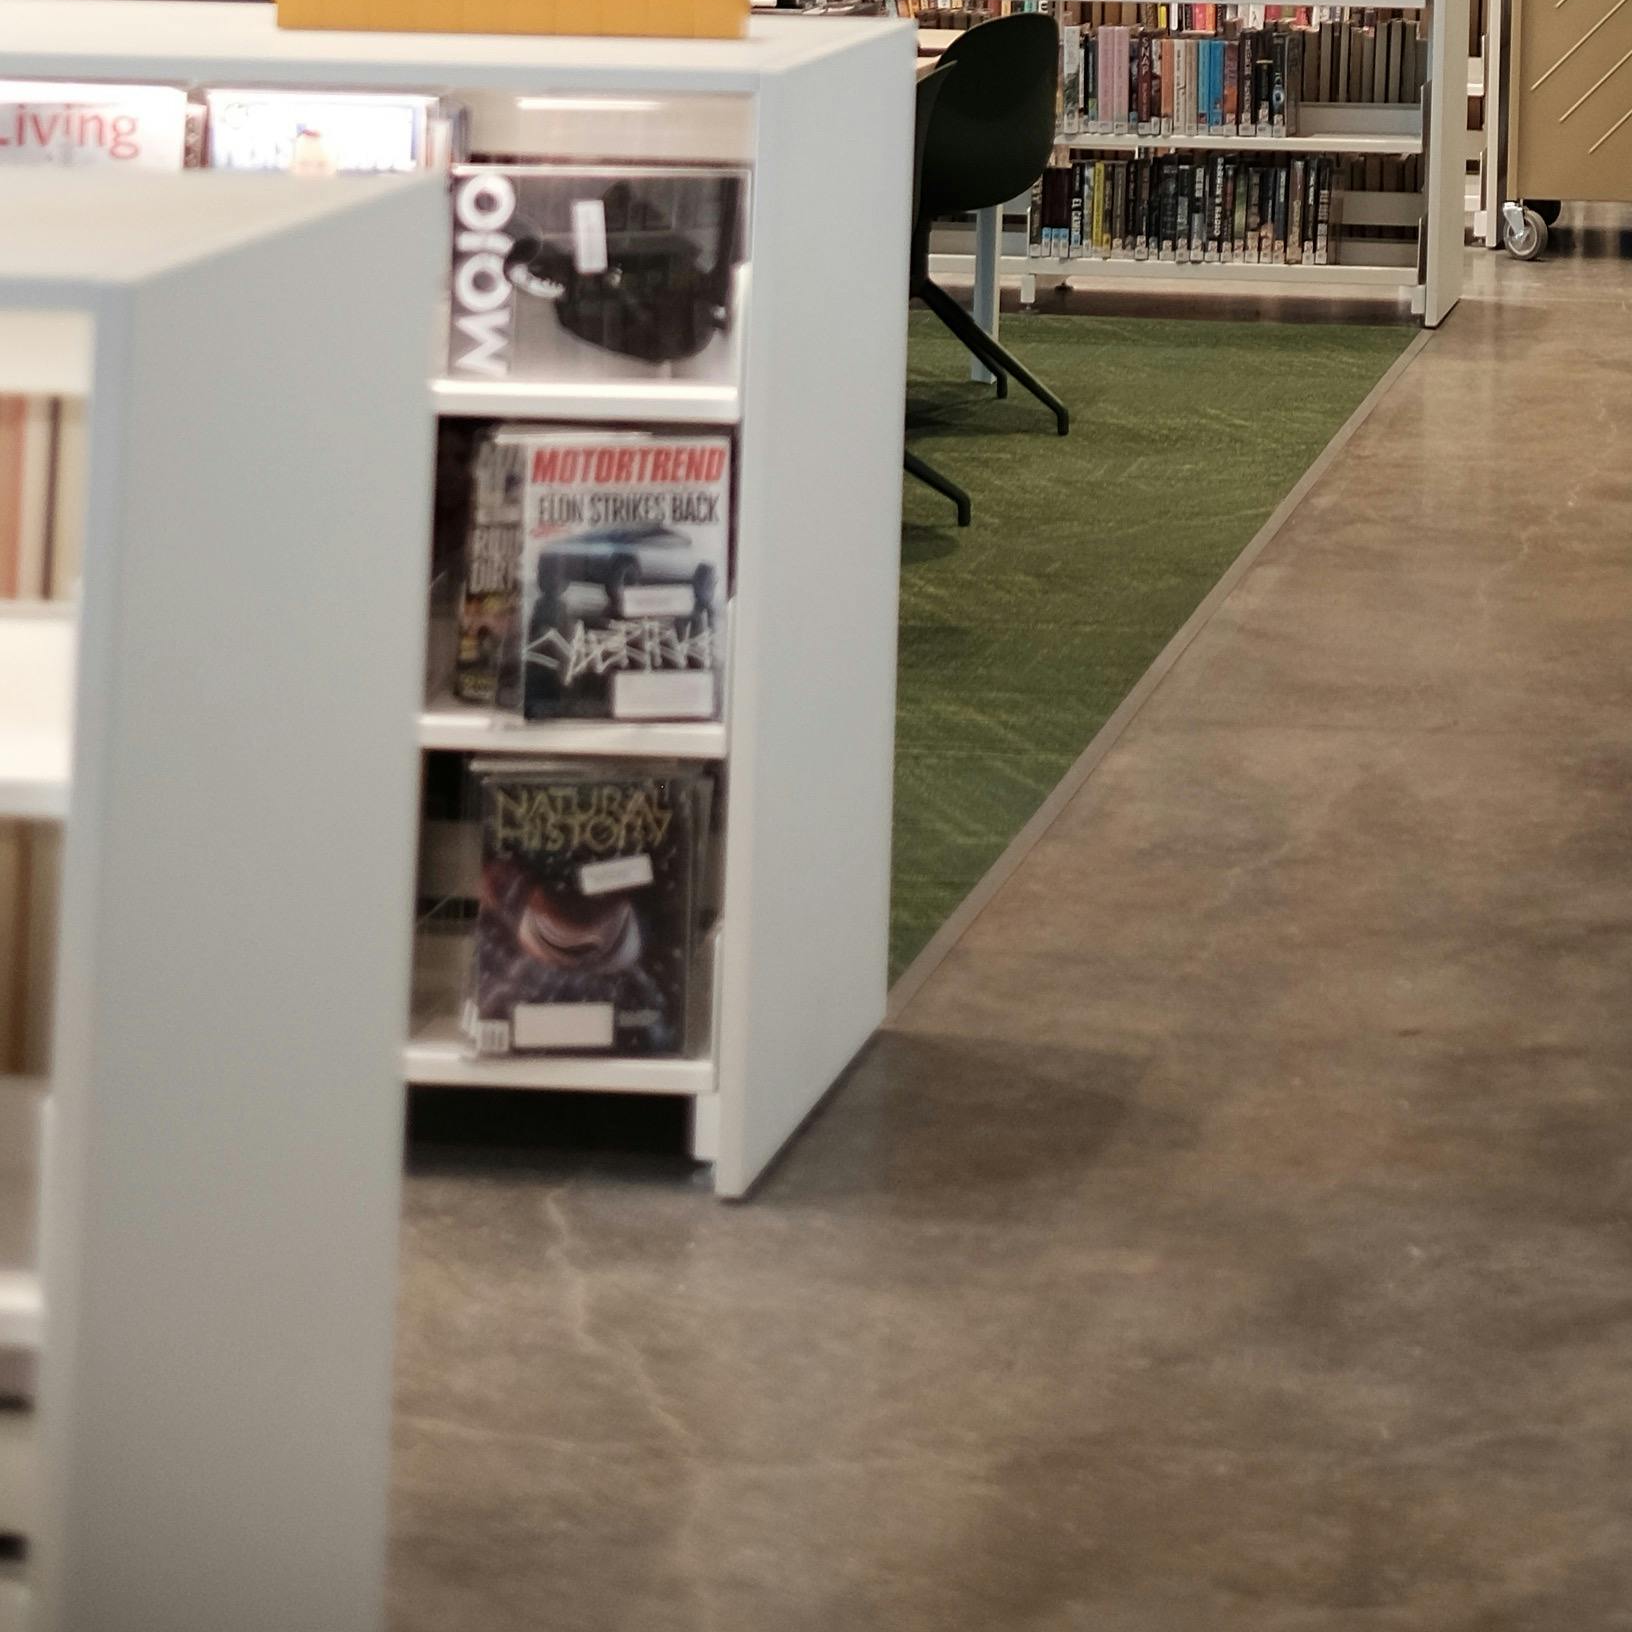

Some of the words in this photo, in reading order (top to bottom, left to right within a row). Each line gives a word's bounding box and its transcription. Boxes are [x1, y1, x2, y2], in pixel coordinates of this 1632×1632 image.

[531, 444, 727, 484] MOTORTREND
[539, 492, 584, 524] ELON
[590, 492, 667, 524] STRIKES
[671, 491, 720, 524] BACK
[495, 779, 673, 817] NATURAL
[495, 812, 674, 851] HISTORY
